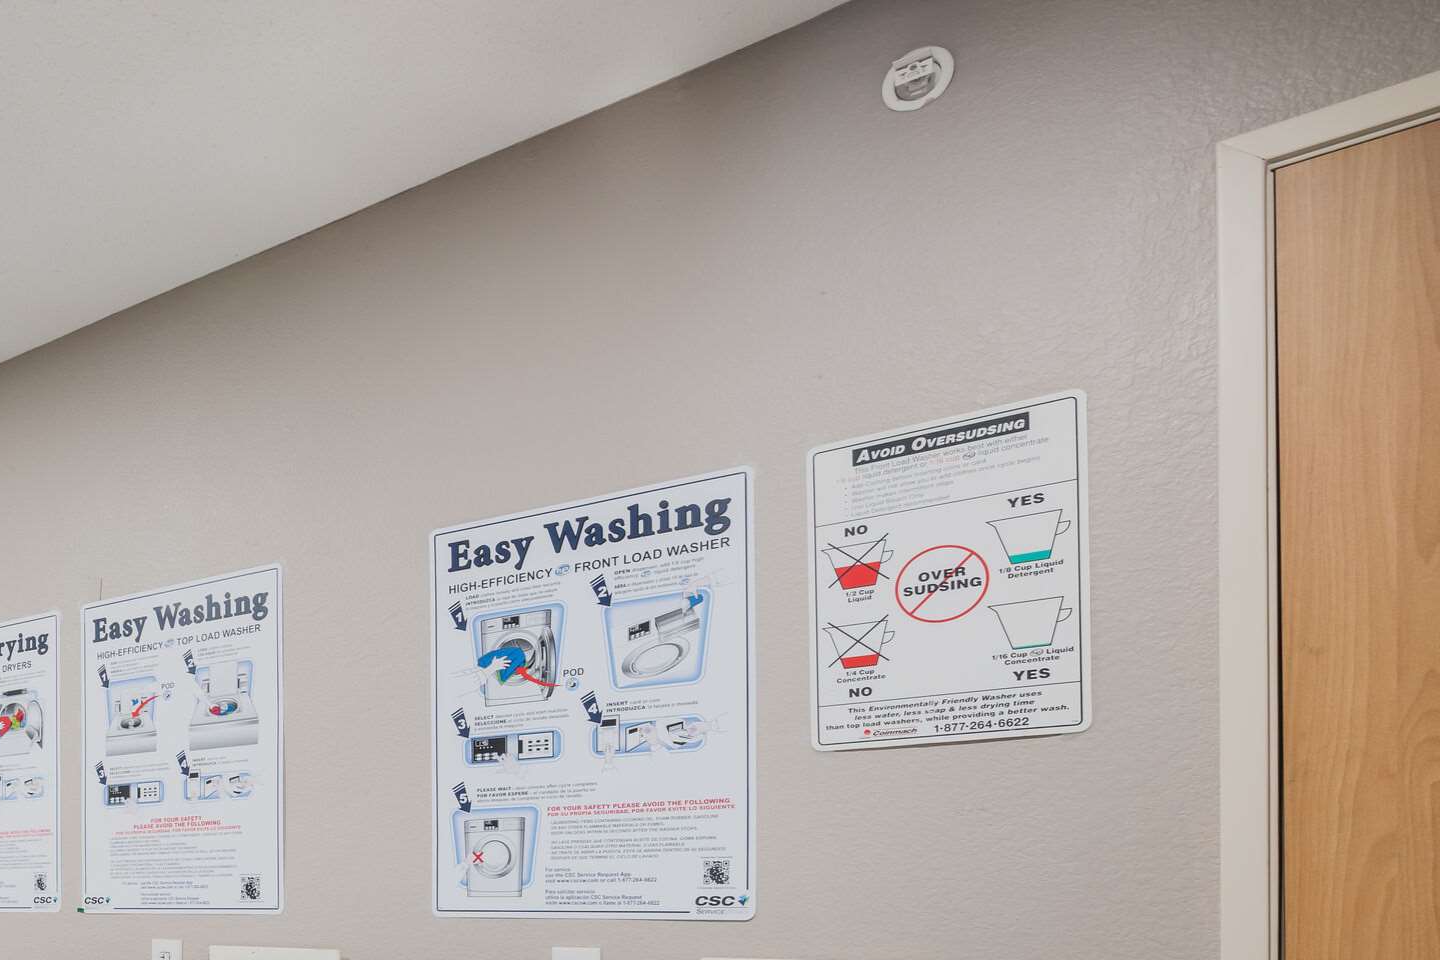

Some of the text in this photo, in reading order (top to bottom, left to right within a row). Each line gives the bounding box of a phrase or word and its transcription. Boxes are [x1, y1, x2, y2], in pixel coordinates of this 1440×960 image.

[1008, 493, 1044, 508] YES
[447, 497, 732, 573] Easy Washing
[844, 525, 868, 537] NO
[449, 567, 554, 595] HIGH-EFFICIENCY
[574, 557, 620, 573] FRONT
[623, 549, 662, 566] LOAD
[666, 537, 731, 559] WASHER
[1014, 564, 1032, 573] Cup
[1035, 560, 1064, 570] Liquid
[918, 567, 966, 584] OVER
[1008, 568, 1054, 579] Detergent
[599, 587, 607, 597] 2
[903, 577, 982, 597] SUDSING
[859, 589, 875, 597] Cup
[848, 596, 872, 604] Liquid
[92, 592, 269, 644] Easy Washing
[457, 612, 463, 623] 1
[97, 623, 261, 661] HIGH-EFFICIENCY TOP LOAD WASHER
[992, 647, 1074, 661] 1/16 Cup Liquid
[1004, 655, 1060, 666] Concentrate
[2, 661, 32, 676] DRYERS
[563, 668, 584, 678] POD
[859, 669, 875, 677] Cup
[837, 675, 887, 684] Concentrate
[1013, 668, 1051, 681] YES
[161, 682, 175, 690] POD
[849, 687, 872, 698] NO
[868, 701, 939, 713] Environmentally
[941, 696, 979, 706] Friendly
[982, 693, 1017, 702] Washer
[981, 701, 1010, 710] drying
[589, 705, 598, 715] 4
[926, 714, 950, 722] while
[953, 710, 997, 721] providing
[1008, 707, 1038, 715] better
[458, 720, 466, 731] 3
[935, 717, 1030, 734] 1-877-264-6622
[460, 794, 469, 804] 5
[684, 798, 731, 806] FOLLOWING
[33, 896, 52, 905] CSC
[84, 897, 104, 905] CSC
[695, 896, 735, 907] CSC
